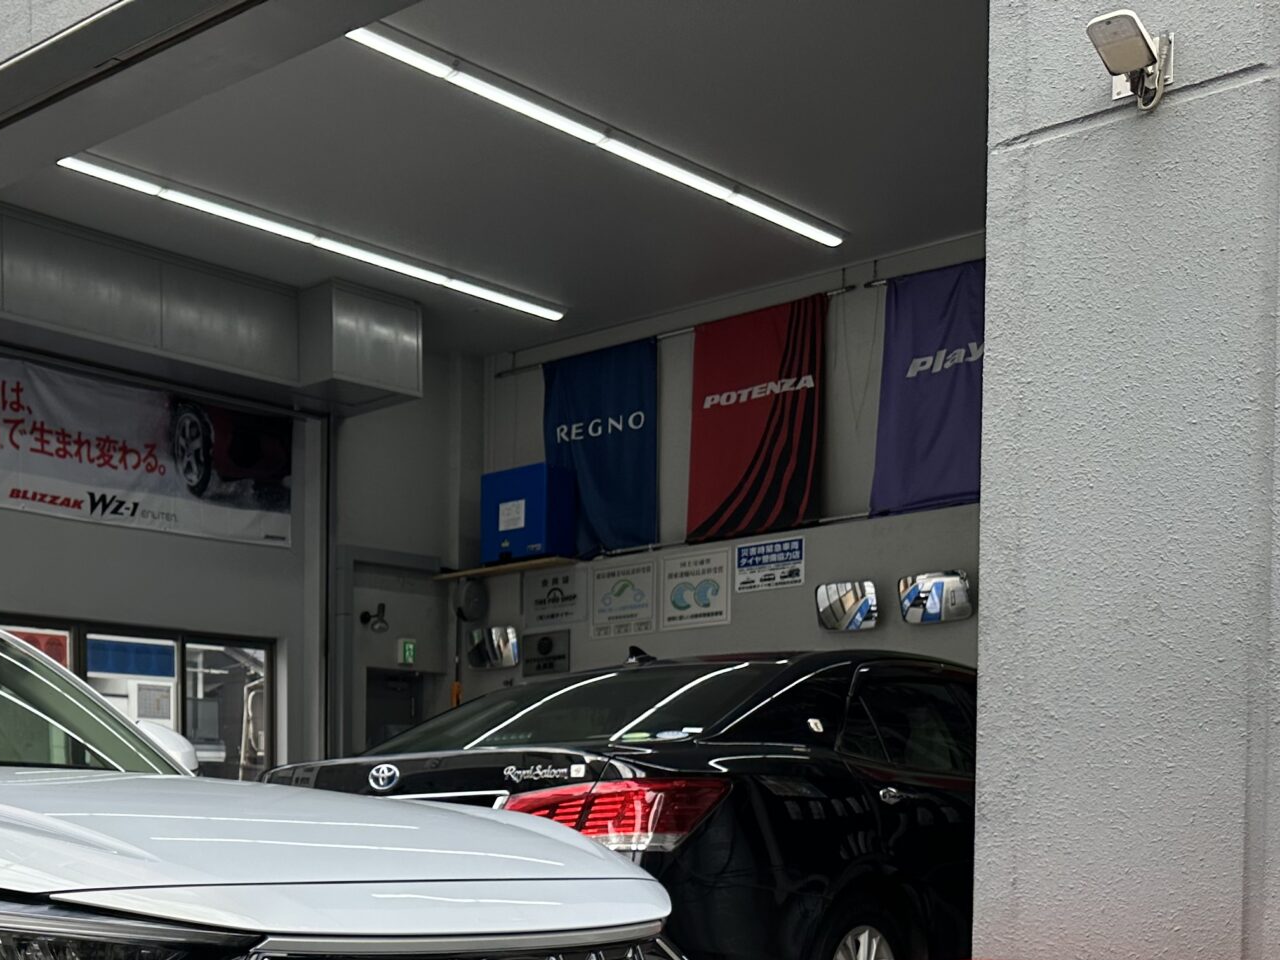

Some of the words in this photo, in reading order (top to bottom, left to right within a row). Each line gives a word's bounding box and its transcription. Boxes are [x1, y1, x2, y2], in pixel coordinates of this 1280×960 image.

[703, 374, 815, 410] POTENZA
[556, 411, 647, 445] REGNO
[9, 488, 85, 511] BLIZZAK
[87, 491, 140, 517] WZ-1
